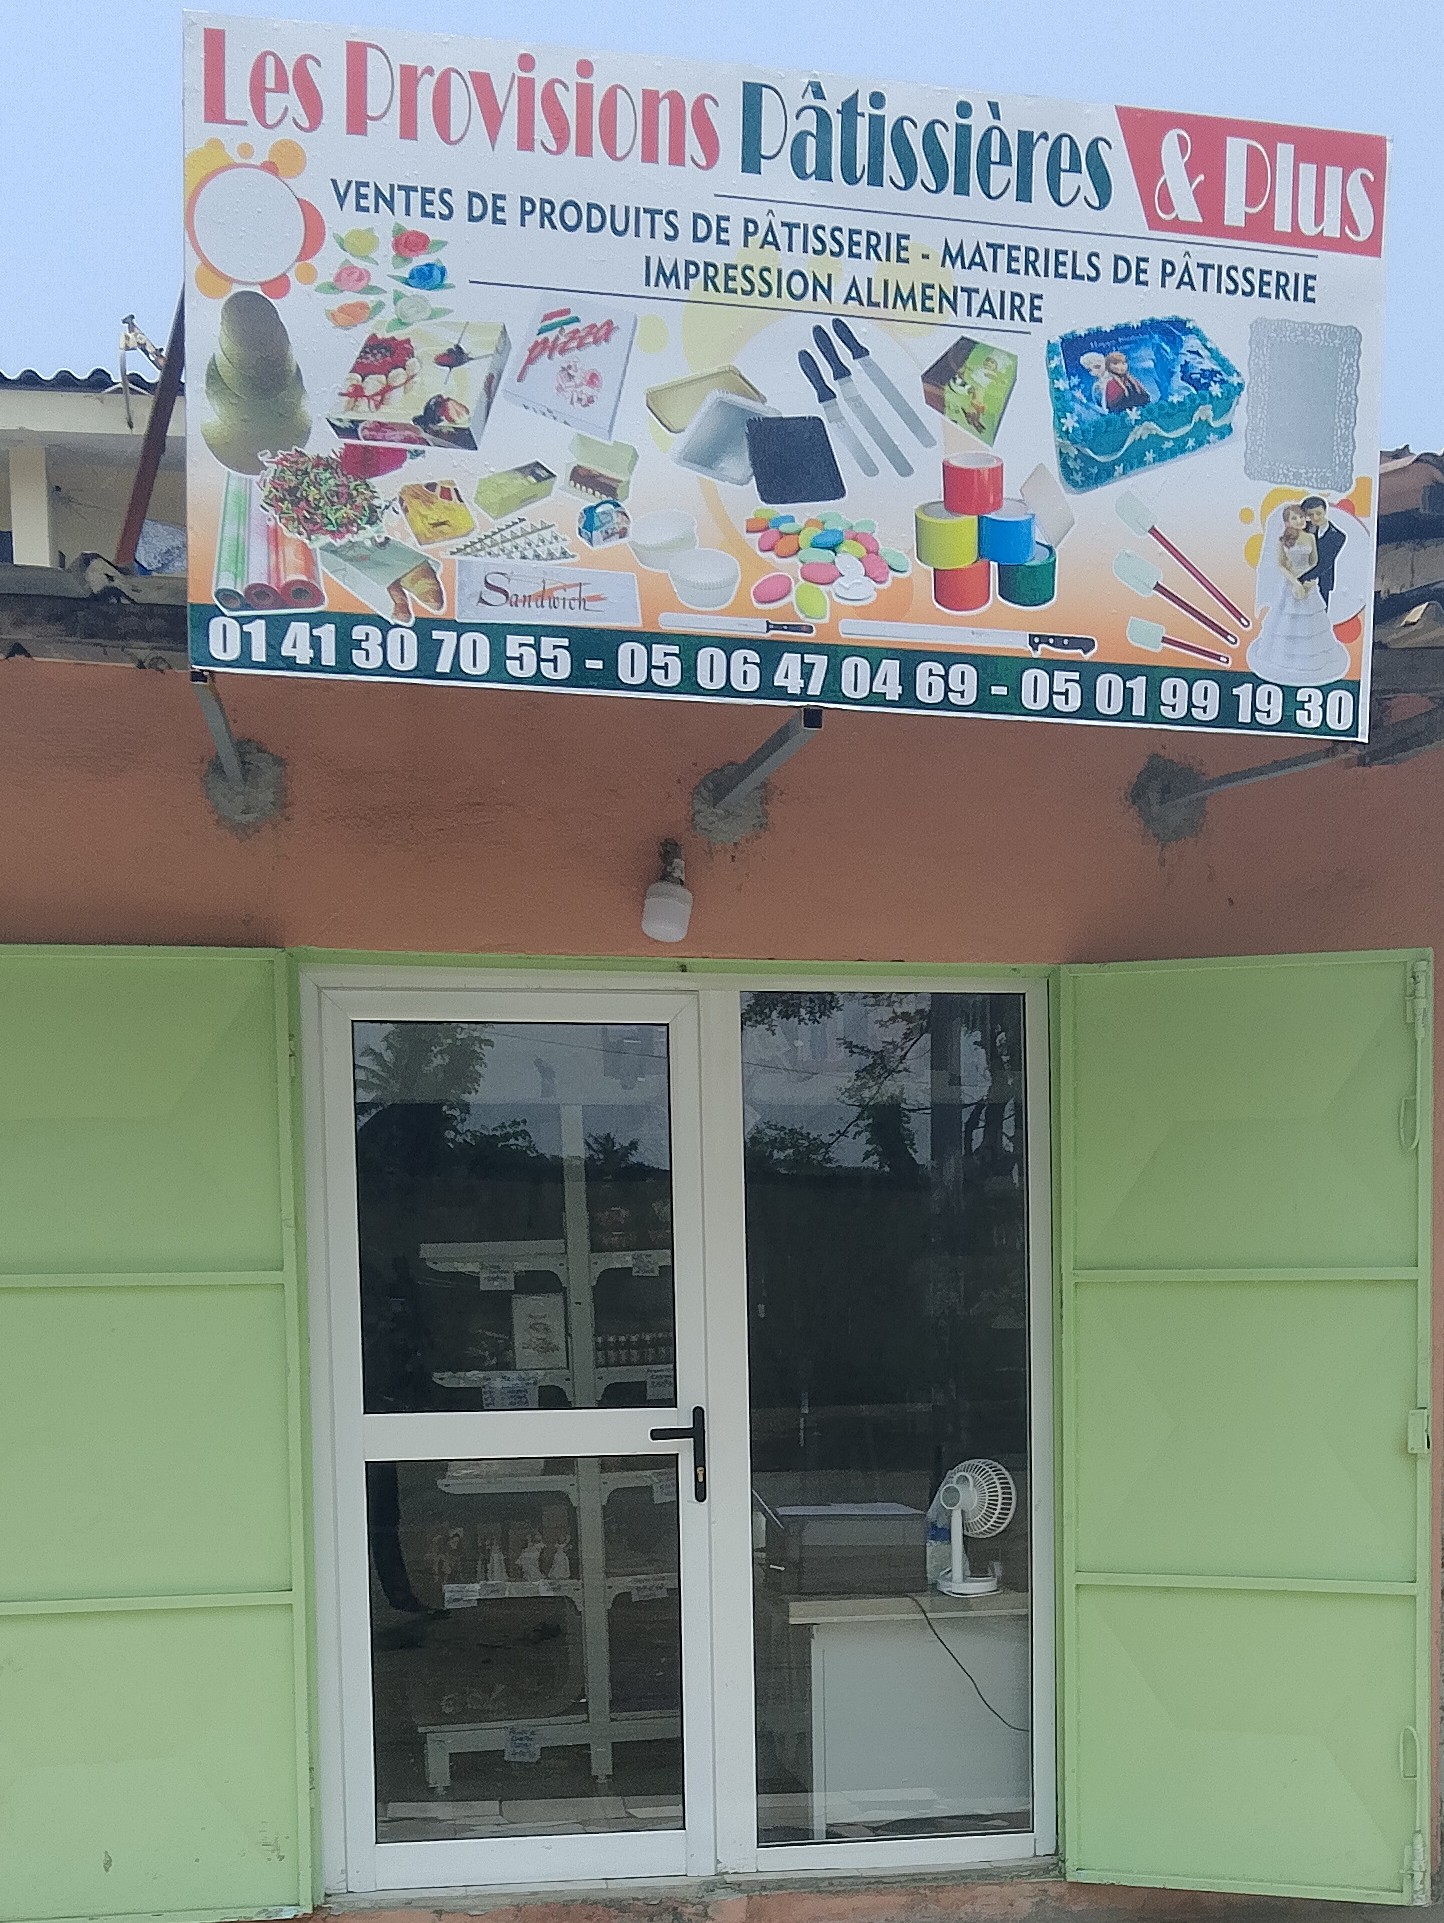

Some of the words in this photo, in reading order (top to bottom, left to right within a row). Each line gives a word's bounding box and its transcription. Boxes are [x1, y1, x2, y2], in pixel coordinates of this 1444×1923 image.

[203, 28, 324, 133] Les
[345, 40, 720, 172] Provisions
[741, 78, 1114, 211] Pâtissières
[1155, 128, 1205, 223] &
[1223, 136, 1376, 242] Plus
[330, 178, 455, 221] VENTES
[467, 191, 507, 227] DE
[520, 195, 679, 242] PRODUITS
[692, 210, 730, 247] DE
[744, 209, 911, 265] PÂTISSERIE
[941, 238, 1101, 283] MATERIELS
[1112, 254, 1149, 287] DE
[1161, 251, 1317, 304] PÂTISSERIE
[644, 256, 833, 304] IMPRESSION
[843, 275, 1043, 324] ALIMENTAIRE
[517, 319, 619, 383] pizza
[476, 571, 605, 613] Sandwich
[208, 616, 267, 663] 01
[281, 621, 338, 667] 41
[351, 624, 418, 671] 30
[432, 630, 491, 675] 70
[506, 635, 572, 680] 55
[586, 658, 604, 669] -
[617, 641, 683, 688] 05
[696, 647, 761, 692] 06
[774, 652, 828, 696] 47
[841, 657, 902, 701] 04
[915, 661, 978, 706] 69
[991, 685, 1008, 696] -
[1021, 667, 1081, 713] 05
[1095, 673, 1146, 717] 01
[1159, 677, 1220, 721] 99
[1232, 682, 1283, 726] 19
[1296, 687, 1355, 731] 30
